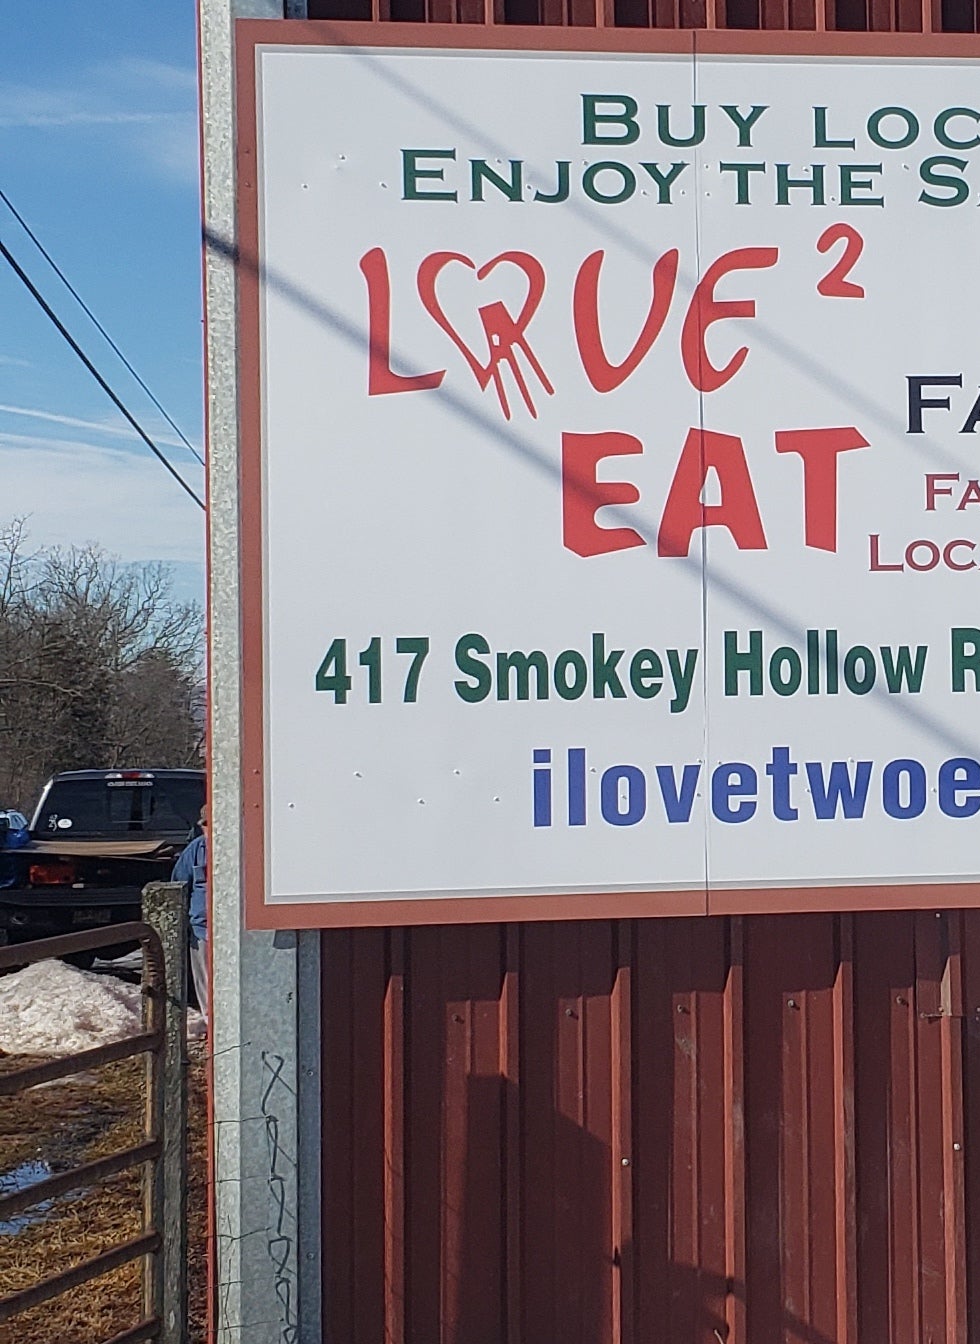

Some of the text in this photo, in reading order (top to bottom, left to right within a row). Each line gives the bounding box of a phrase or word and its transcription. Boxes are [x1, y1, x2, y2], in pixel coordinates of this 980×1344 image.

[816, 223, 865, 298] 2
[562, 427, 872, 558] EAT
[315, 637, 430, 705] 417
[454, 633, 699, 713] Smokey
[724, 629, 928, 696] Hollow
